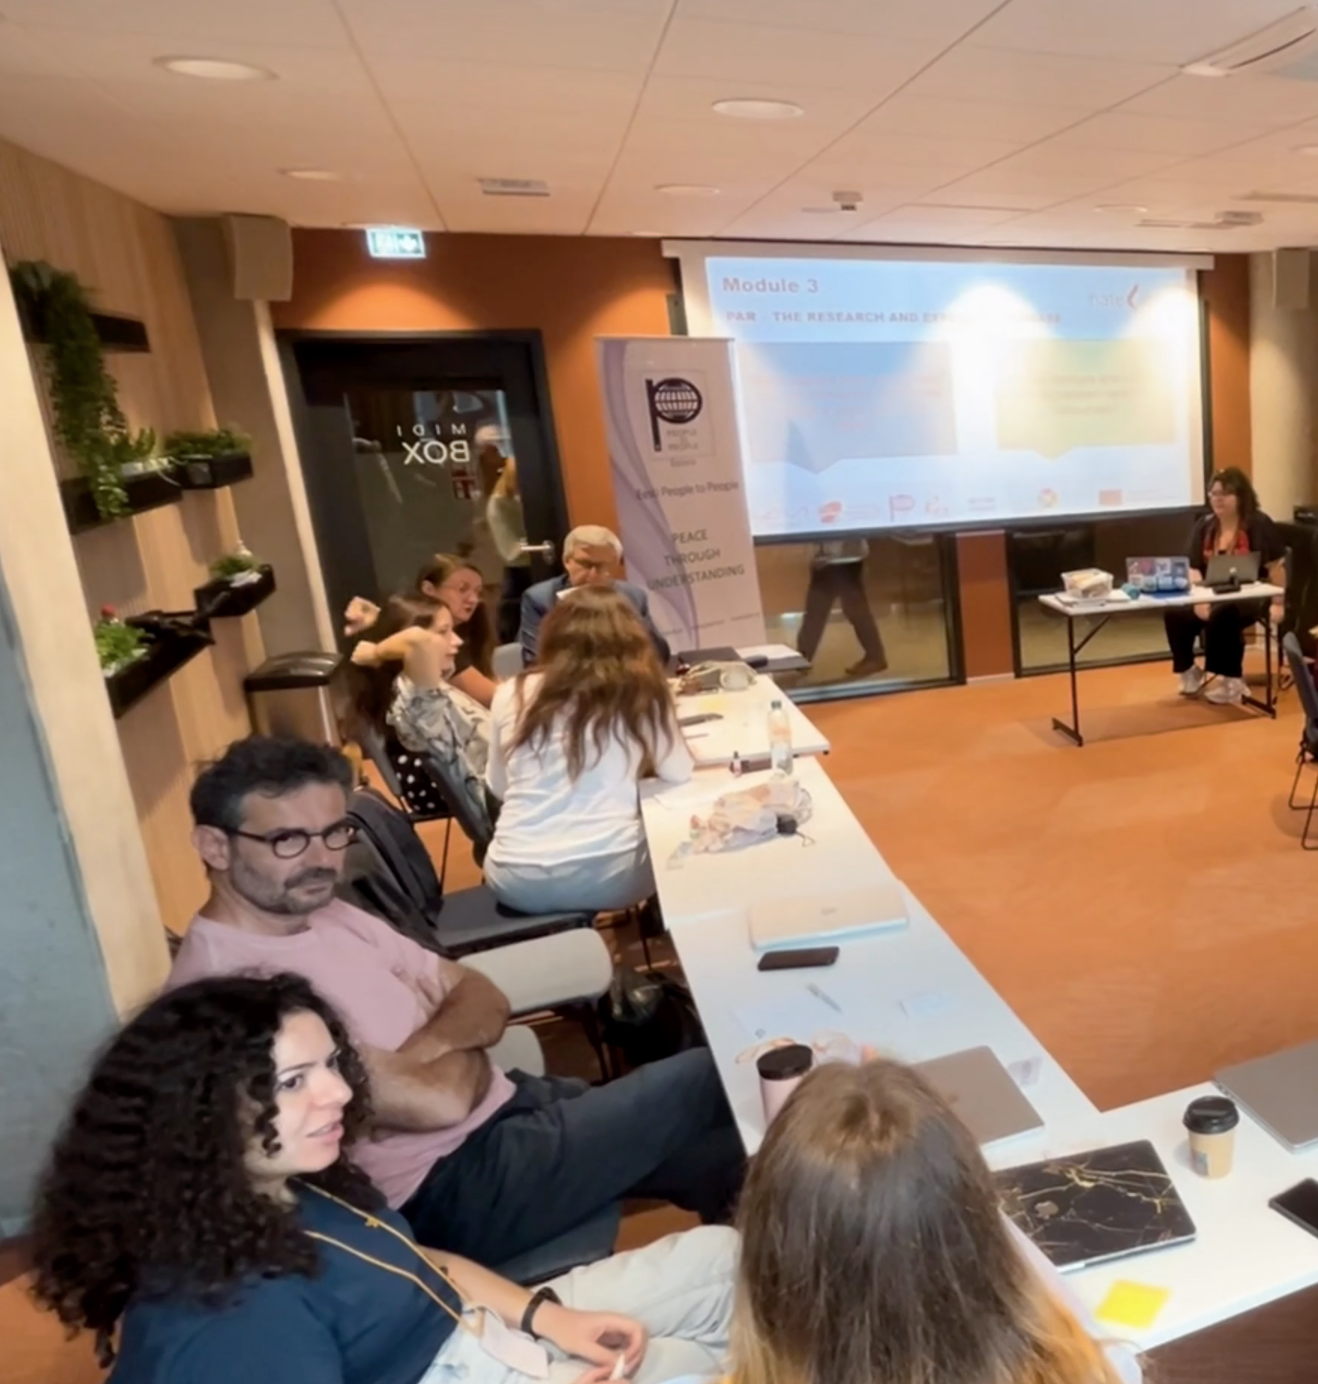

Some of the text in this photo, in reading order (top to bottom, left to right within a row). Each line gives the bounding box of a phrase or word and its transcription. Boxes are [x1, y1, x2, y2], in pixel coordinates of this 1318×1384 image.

[721, 277, 819, 294] Module 3
[771, 311, 802, 323] THE
[806, 311, 885, 324] RESEARCH
[888, 312, 918, 324] AND
[660, 485, 694, 498] People
[694, 483, 706, 494] to
[706, 481, 739, 493] People
[670, 528, 708, 544] PEACE
[663, 547, 721, 567] THROUGH
[647, 563, 746, 591] UNDERSTANDING
